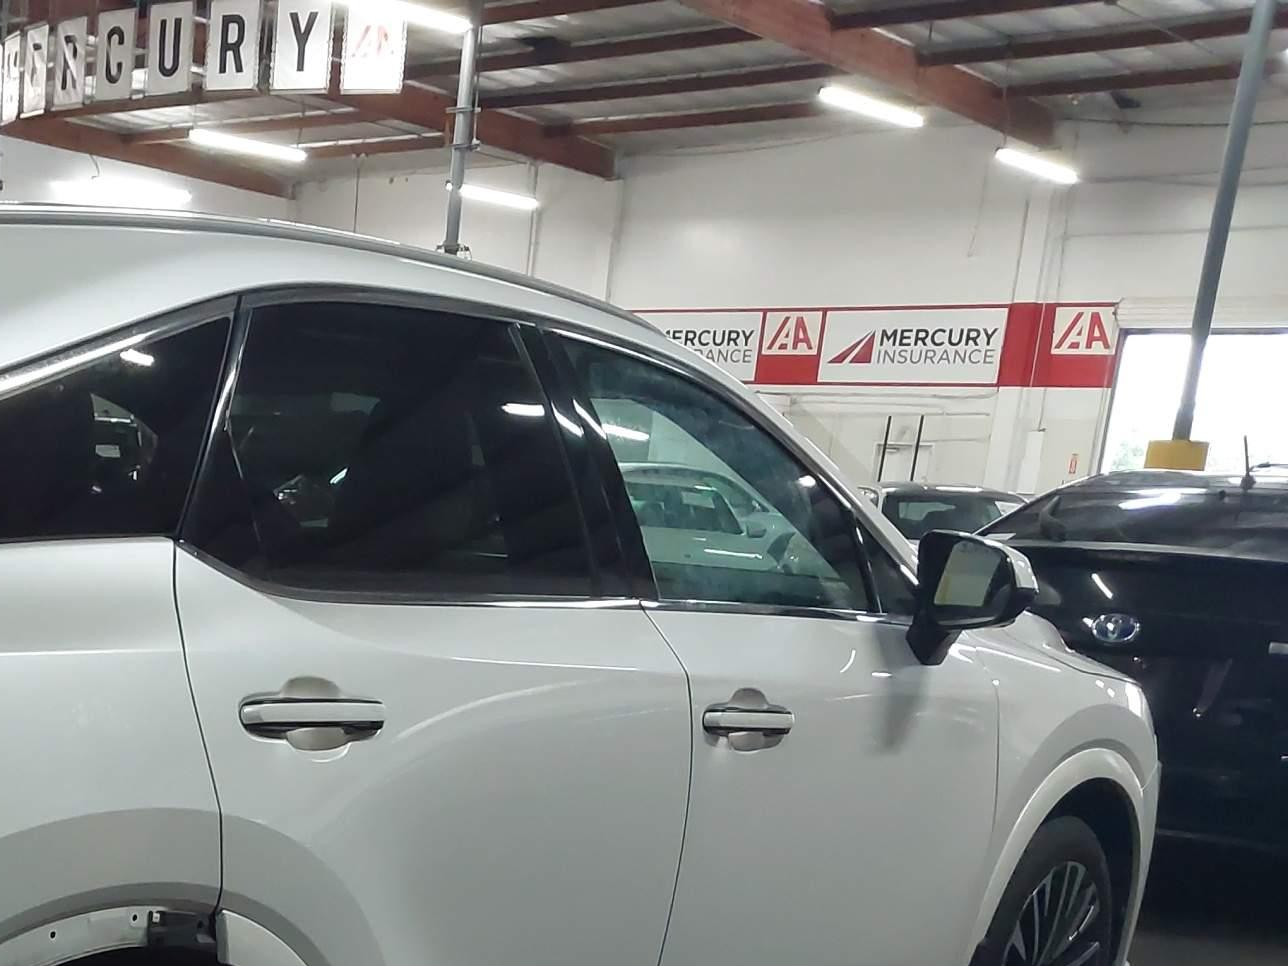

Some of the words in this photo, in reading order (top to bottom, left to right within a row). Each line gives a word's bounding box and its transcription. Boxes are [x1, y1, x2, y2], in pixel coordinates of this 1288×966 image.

[665, 329, 755, 347] ERCURY
[879, 328, 999, 347] MERCURY
[876, 349, 995, 364] INSURANCE
